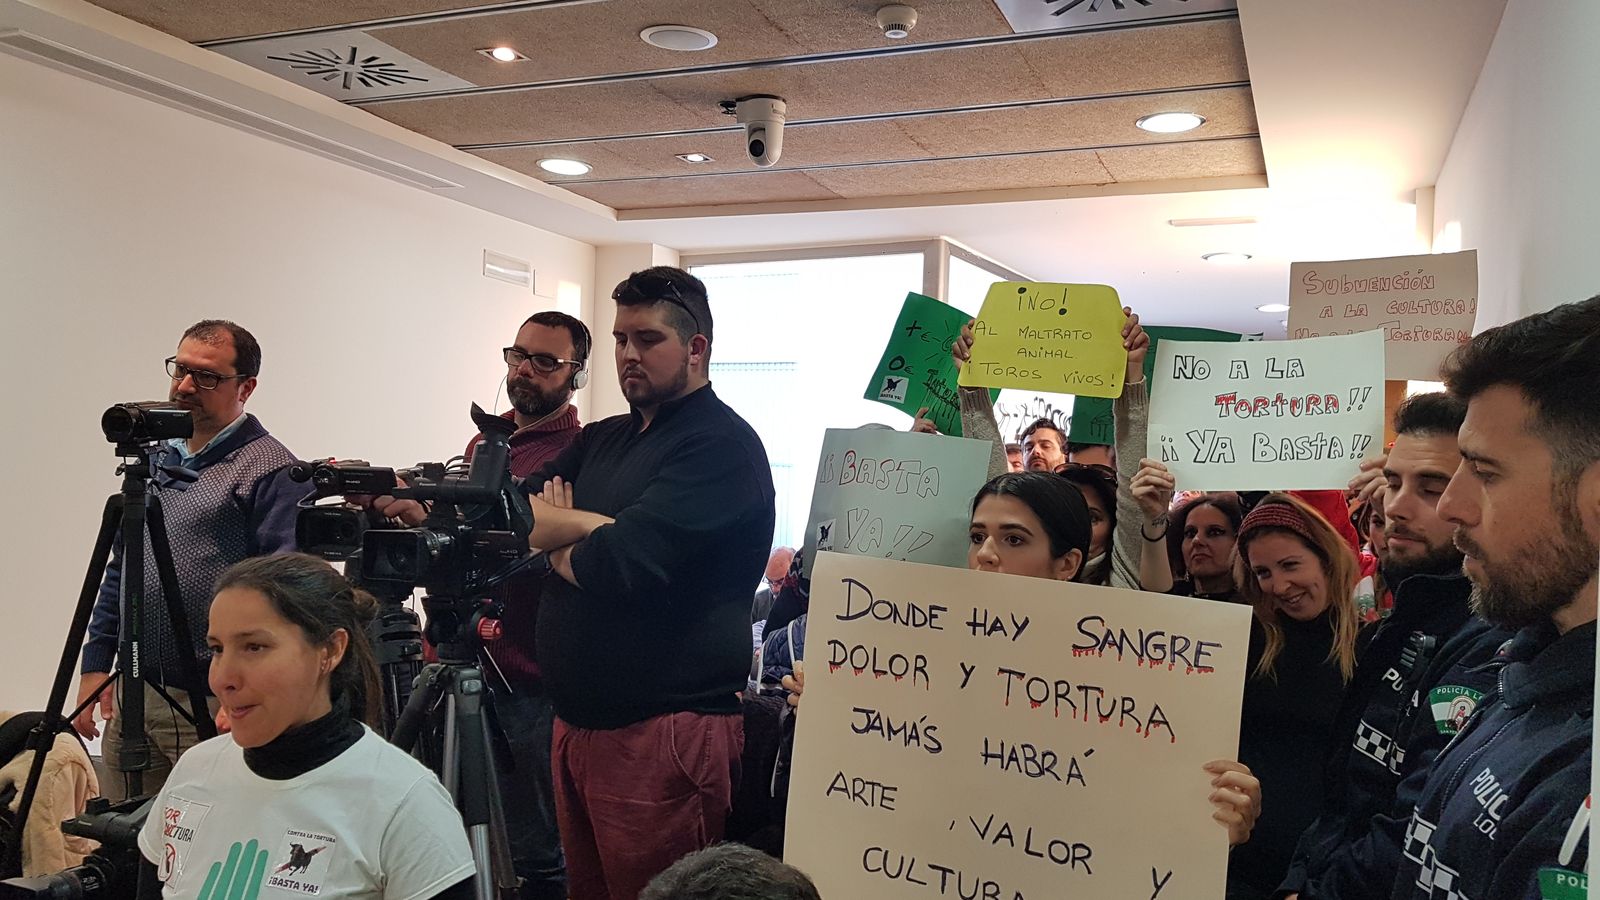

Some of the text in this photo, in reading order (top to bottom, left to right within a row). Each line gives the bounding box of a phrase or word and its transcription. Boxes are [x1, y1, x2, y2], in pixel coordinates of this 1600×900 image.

[1016, 286, 1068, 316] ¡NO!
[1319, 297, 1476, 318] A LA CULTURA!
[974, 320, 1093, 340] AL MALTRATO
[1172, 354, 1305, 380] NO A LA
[835, 577, 1223, 675] DONDE HAY SANGRE
[131, 641, 139, 678] CULLMANN
[827, 639, 1176, 744] DOLOR Y TORTURA
[850, 706, 1095, 787] JAMÁS HABRÁ
[825, 770, 898, 812] ARTE
[1151, 866, 1173, 900] Y
[268, 876, 319, 893] ¡BASTA YA!
